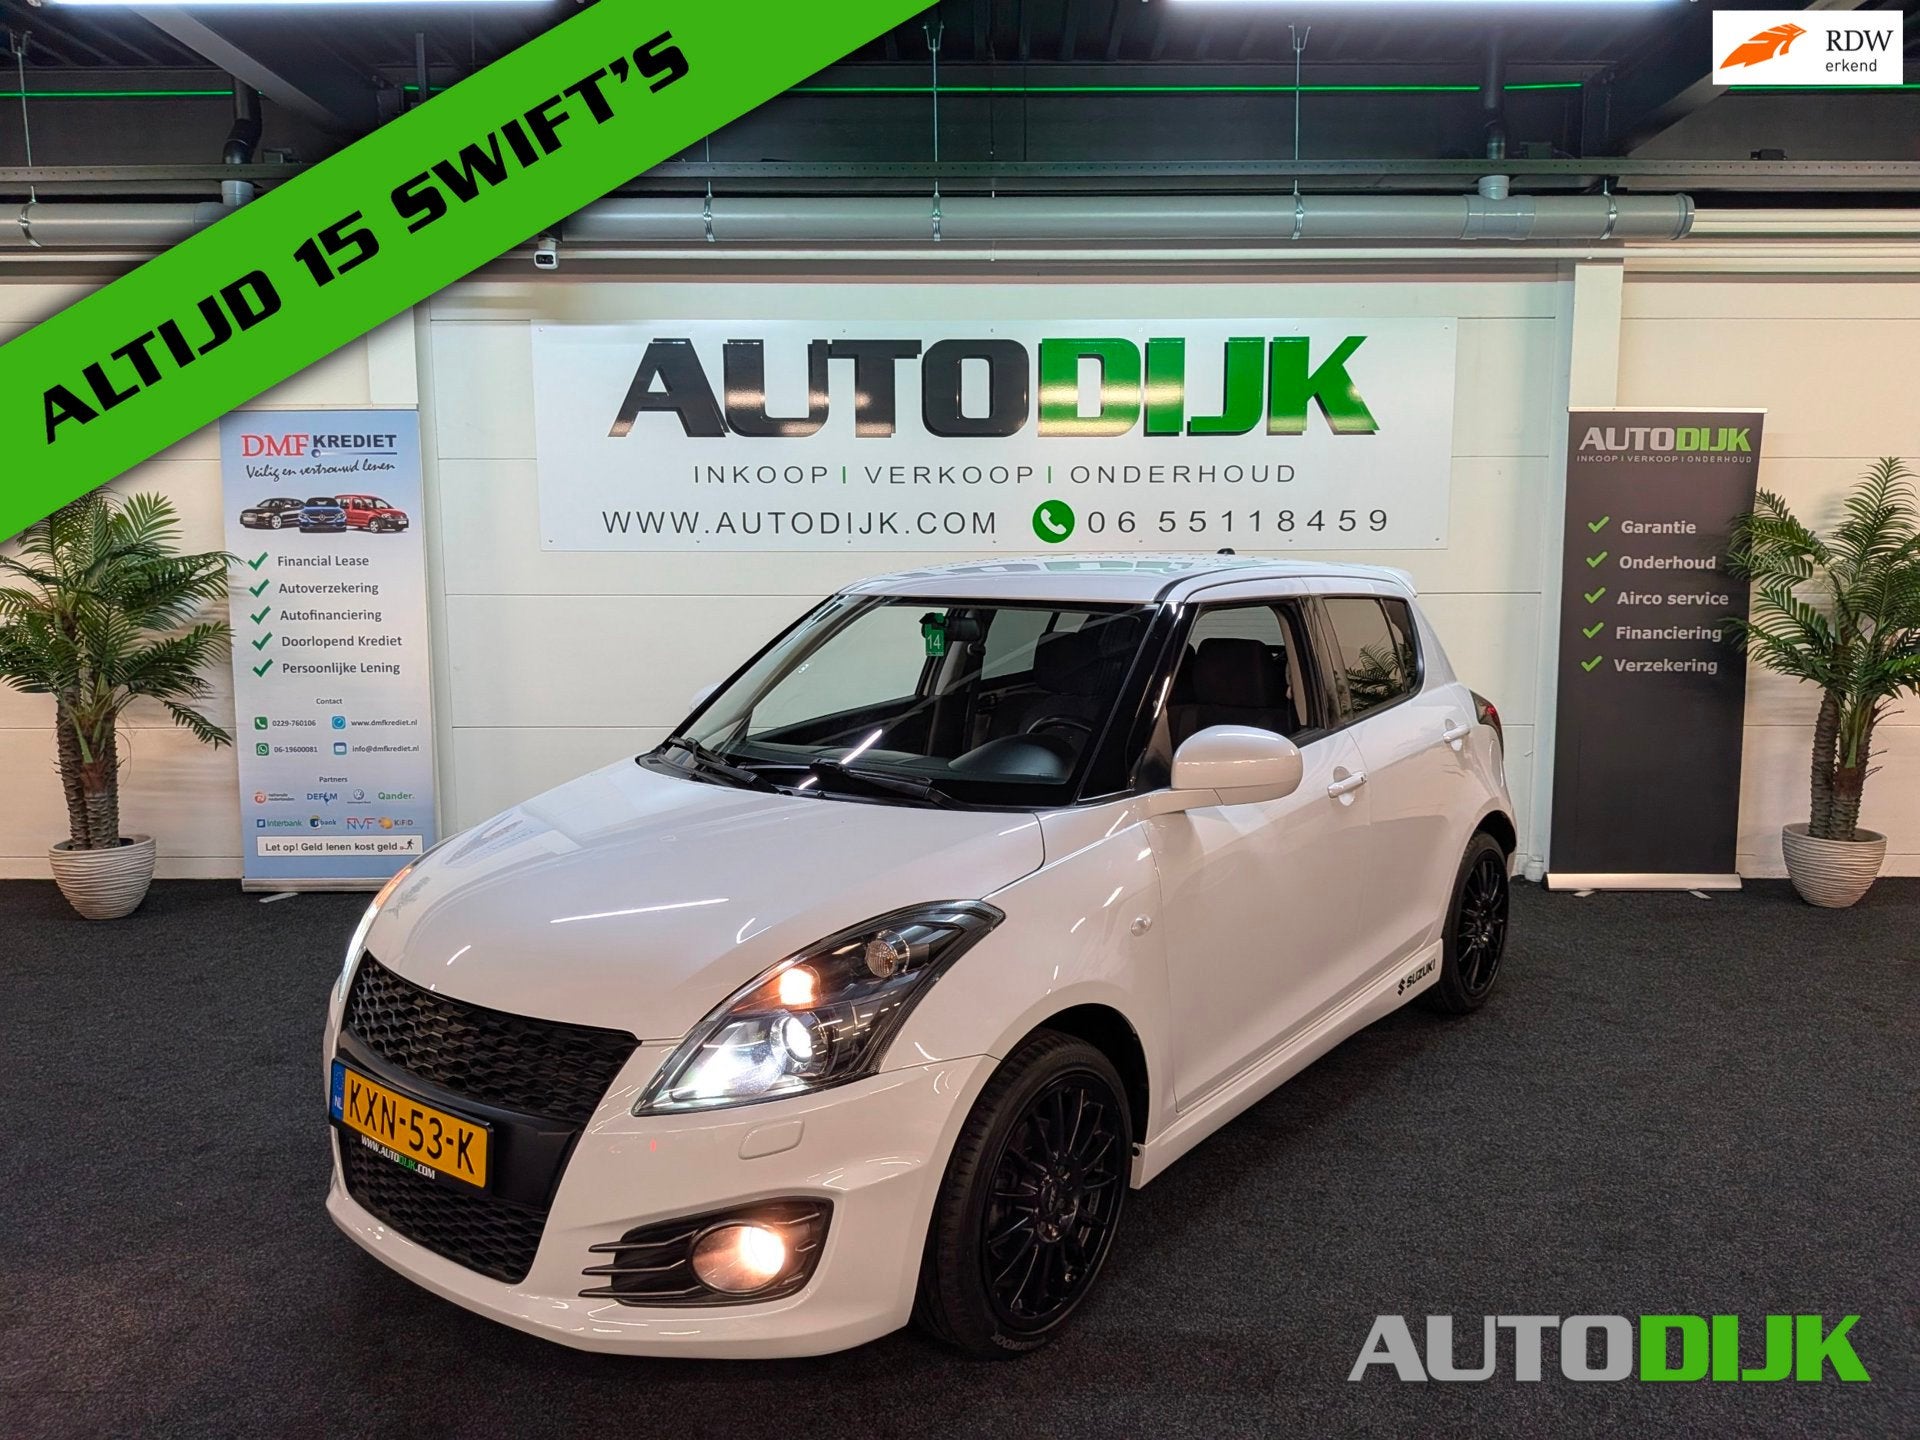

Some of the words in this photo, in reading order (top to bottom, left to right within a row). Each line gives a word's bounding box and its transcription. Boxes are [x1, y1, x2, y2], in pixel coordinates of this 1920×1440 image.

[607, 336, 1380, 438] AUTODIJK
[241, 433, 309, 457] DMF
[313, 434, 397, 448] KREDIET
[1579, 427, 1751, 452] AUTODIJK
[246, 464, 280, 482] Veilig
[282, 466, 297, 476] en
[300, 459, 359, 476] vertrouwd
[362, 458, 396, 471] lenen
[694, 465, 828, 484] INKOOP
[864, 465, 1034, 484] VERKOOP
[1070, 464, 1296, 484] ONDERHOUD
[602, 510, 996, 535] WWW.AUTODIJK.COM
[1621, 520, 1697, 534] Garantie
[277, 556, 332, 566] Financial
[335, 556, 369, 566] Lease
[1619, 556, 1716, 569] Onderhoud
[278, 582, 379, 596] Autoverzekering
[1617, 591, 1662, 605] Airco
[1667, 591, 1729, 605] service
[280, 609, 382, 622] Autofinanciering
[927, 633, 941, 650] 14
[1615, 626, 1722, 642] Financiering
[282, 635, 355, 649] Doorlopend
[358, 635, 402, 647] Krediet
[282, 662, 357, 675] Persoonlijke
[360, 662, 400, 675] Lening
[1614, 659, 1718, 674] Verzekering
[352, 745, 420, 753] info@dmfkrediet.nl
[265, 843, 281, 851] Let
[283, 843, 299, 853] op!
[301, 842, 323, 851] Geld
[325, 842, 351, 851] lenen
[354, 842, 374, 850] kost
[377, 842, 397, 852] geld
[1407, 958, 1436, 988] SUZUKI
[349, 1079, 475, 1175] KXN-53-K
[361, 1134, 436, 1180] WWW.AUTODIJK.COM
